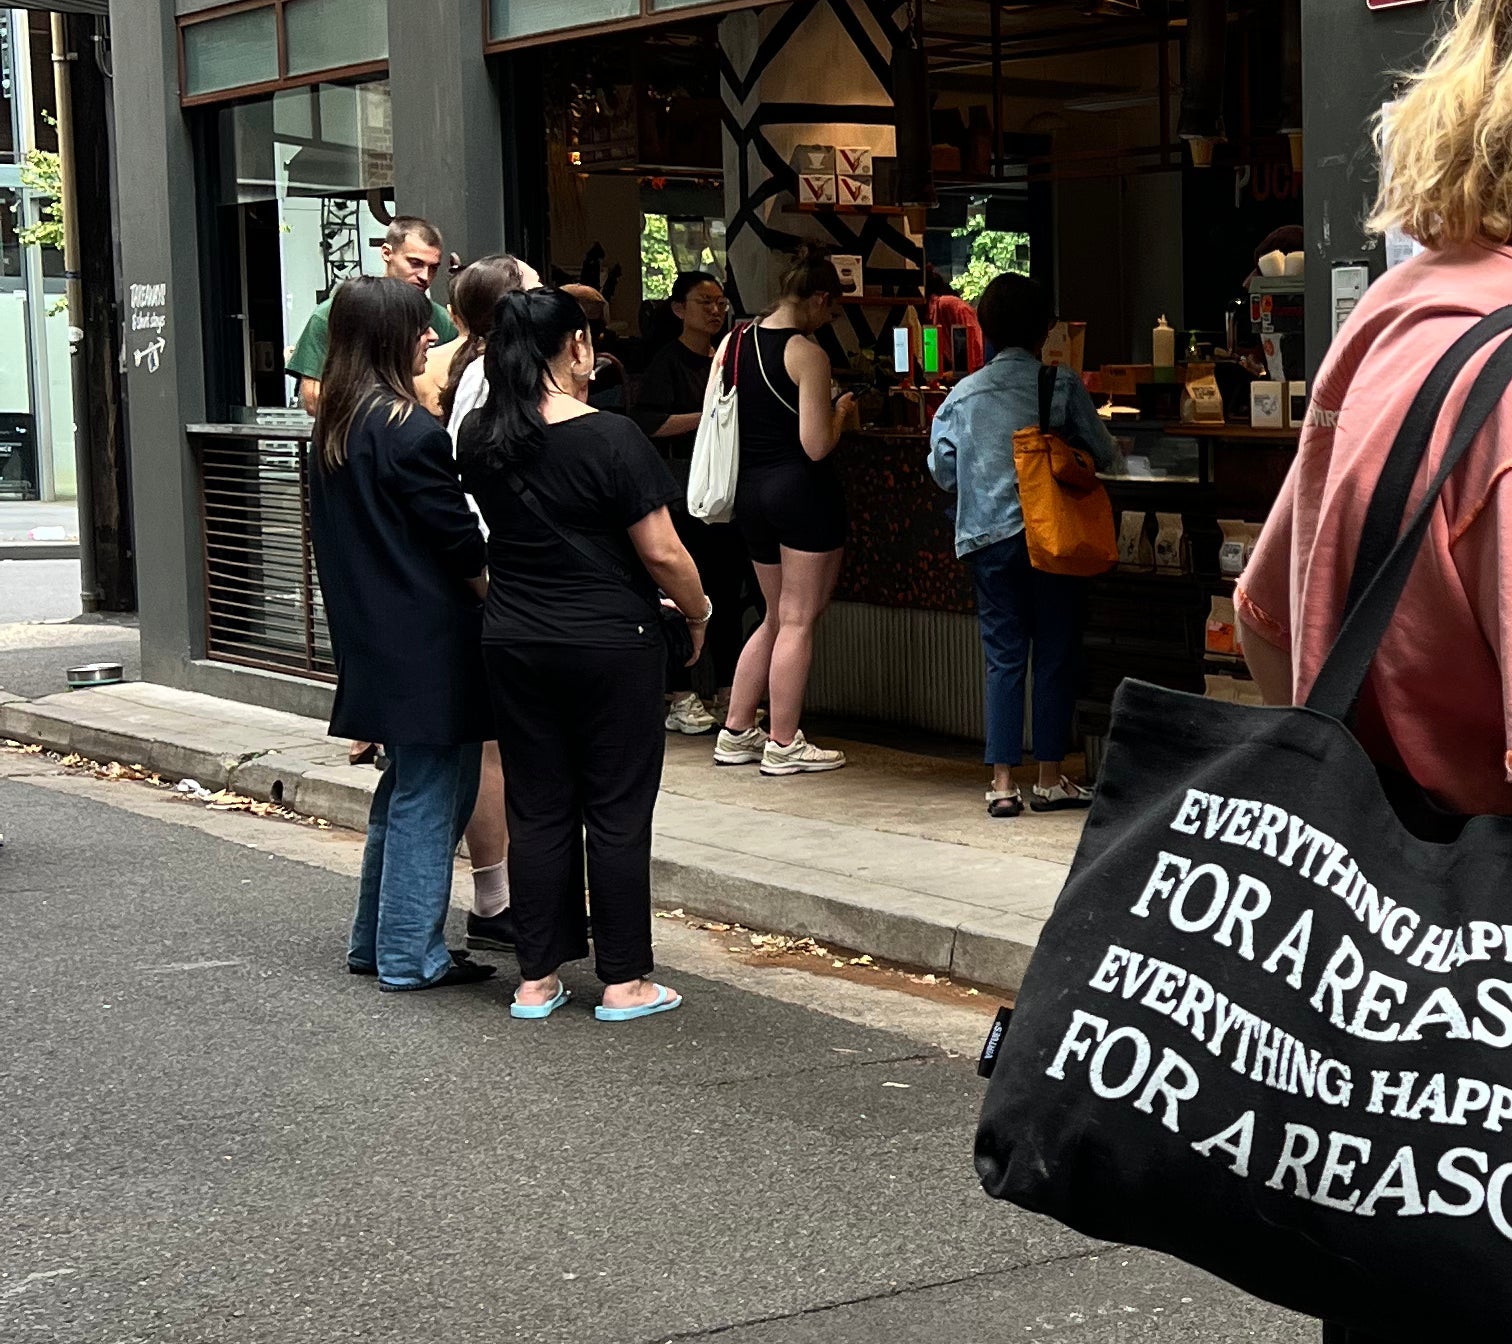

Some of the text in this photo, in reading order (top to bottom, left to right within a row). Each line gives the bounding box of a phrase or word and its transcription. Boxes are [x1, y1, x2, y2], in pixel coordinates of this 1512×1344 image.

[1130, 851, 1272, 961] FOR
[1262, 909, 1315, 990] A
[1170, 788, 1421, 952] EVERYTHING
[1045, 1009, 1201, 1133] FOR
[1191, 1110, 1258, 1178] A
[1089, 944, 1354, 1107] EVERYTHING
